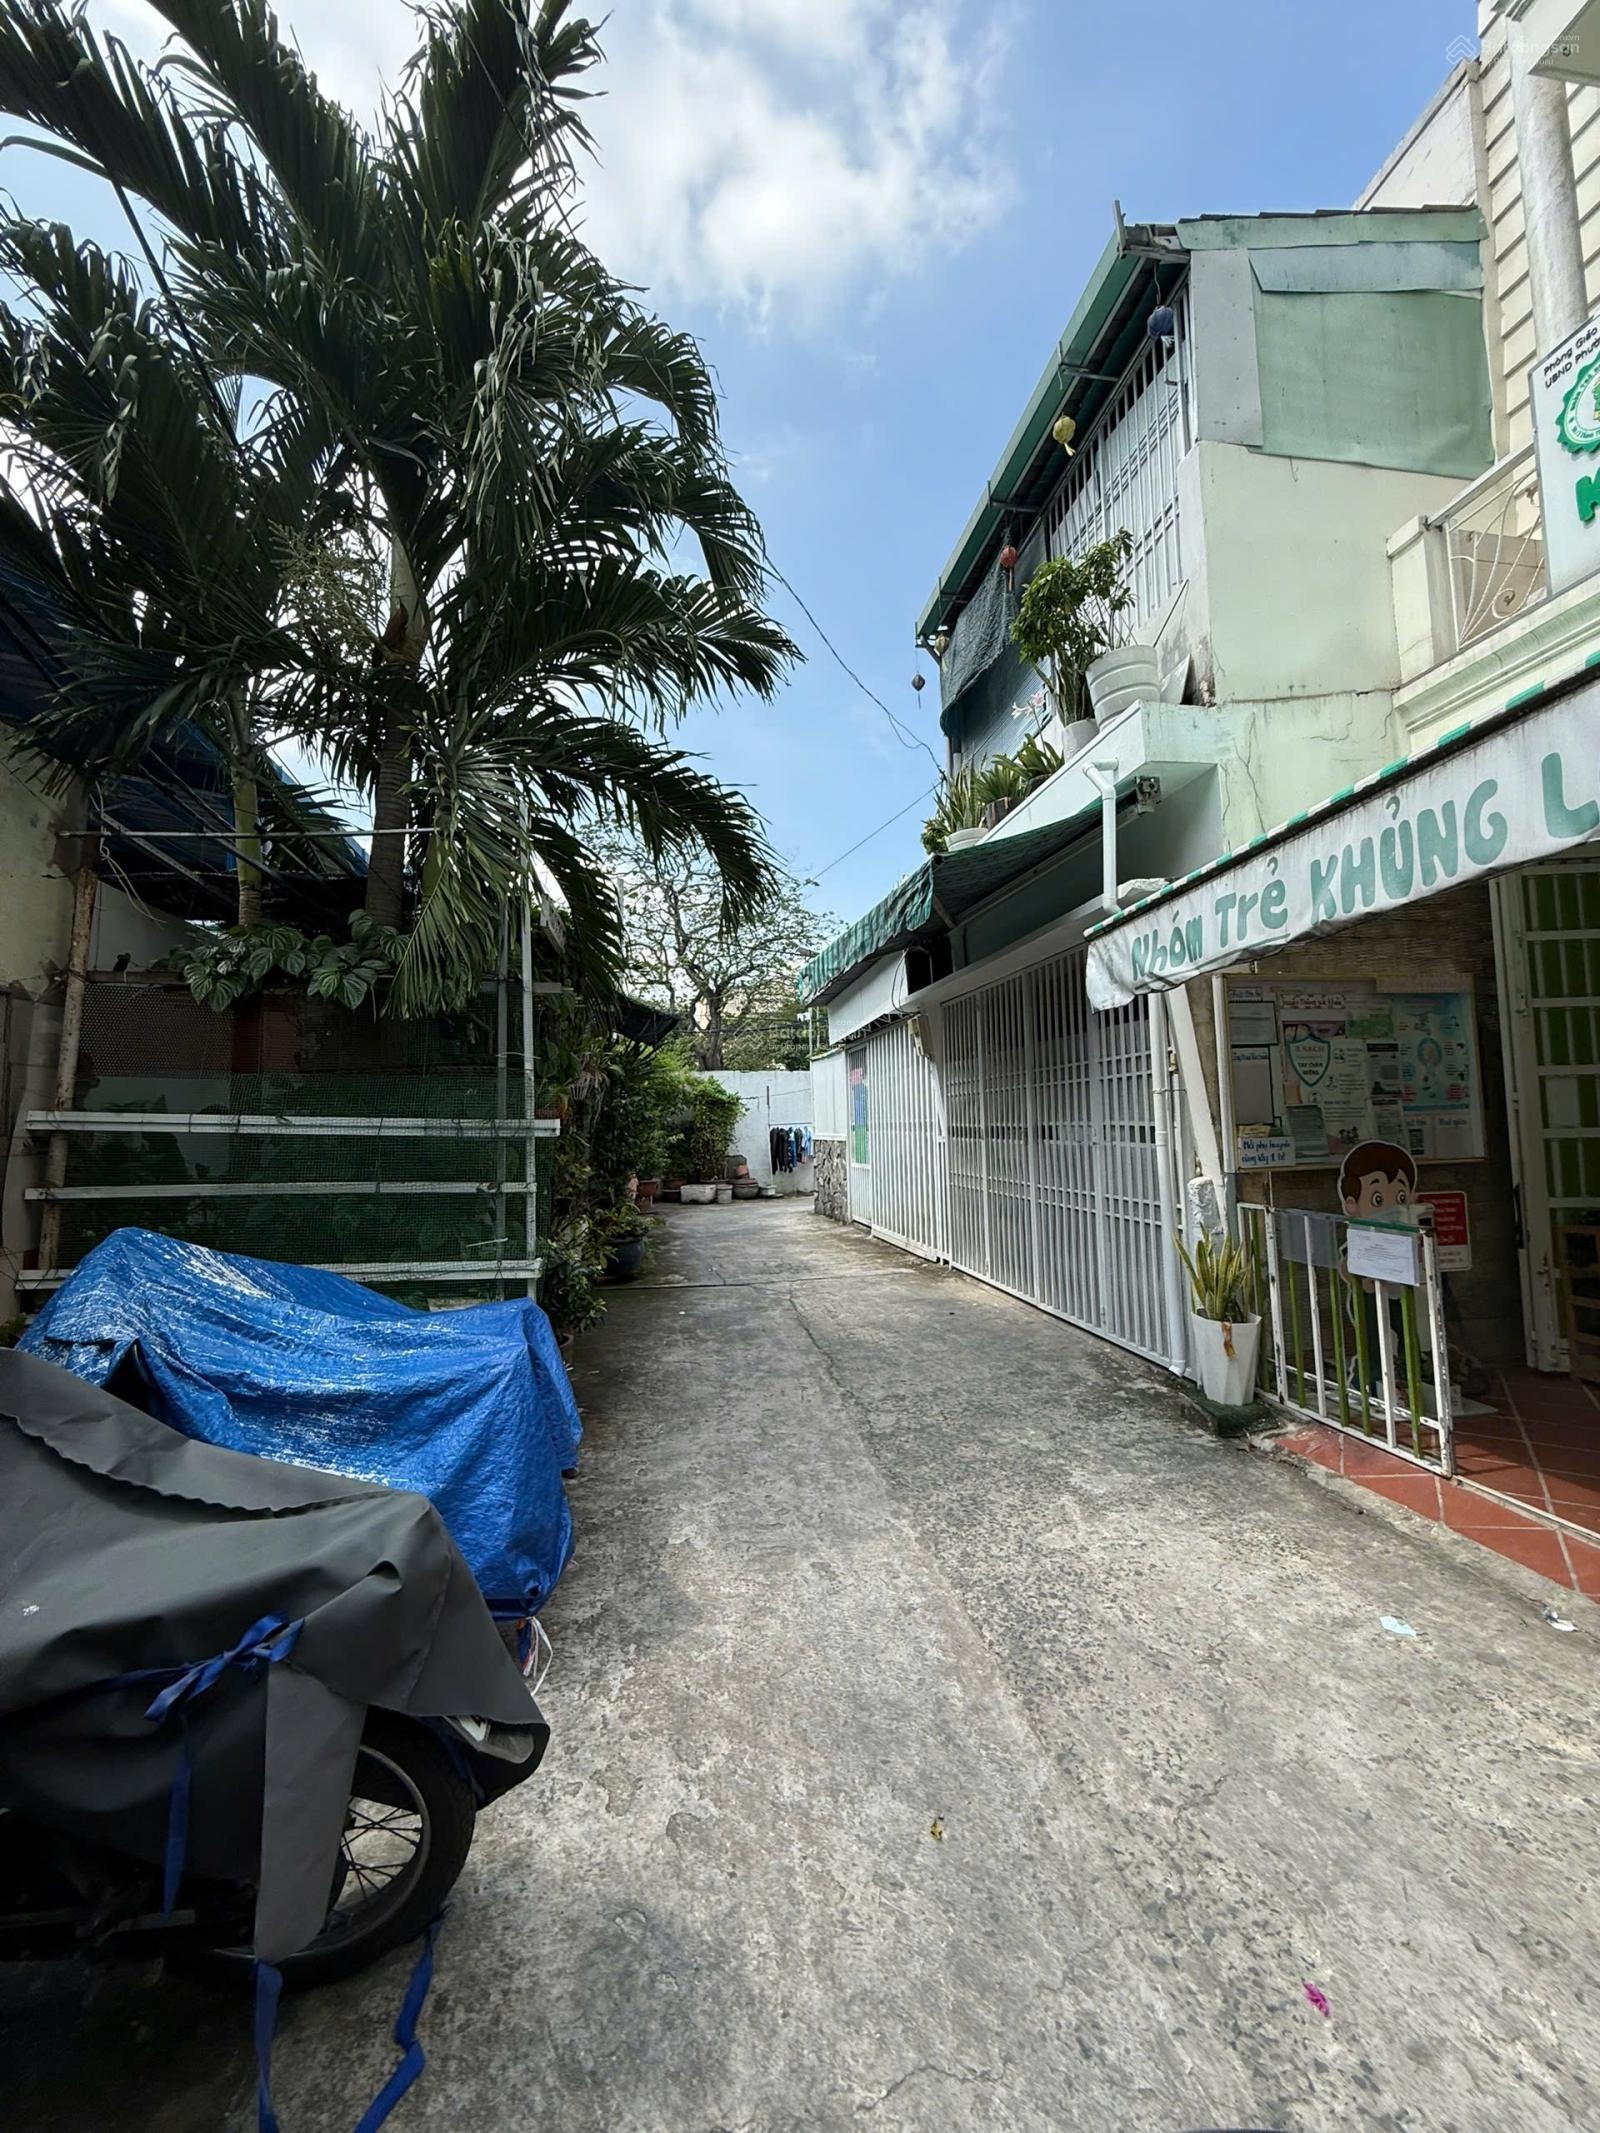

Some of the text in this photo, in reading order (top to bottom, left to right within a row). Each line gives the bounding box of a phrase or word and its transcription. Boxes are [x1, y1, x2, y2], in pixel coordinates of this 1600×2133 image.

[1544, 327, 1598, 376] Phòng Giáo
[1545, 362, 1573, 389] UBND
[1131, 752, 1600, 981] Nhóm Trẻ KHỦNG L
